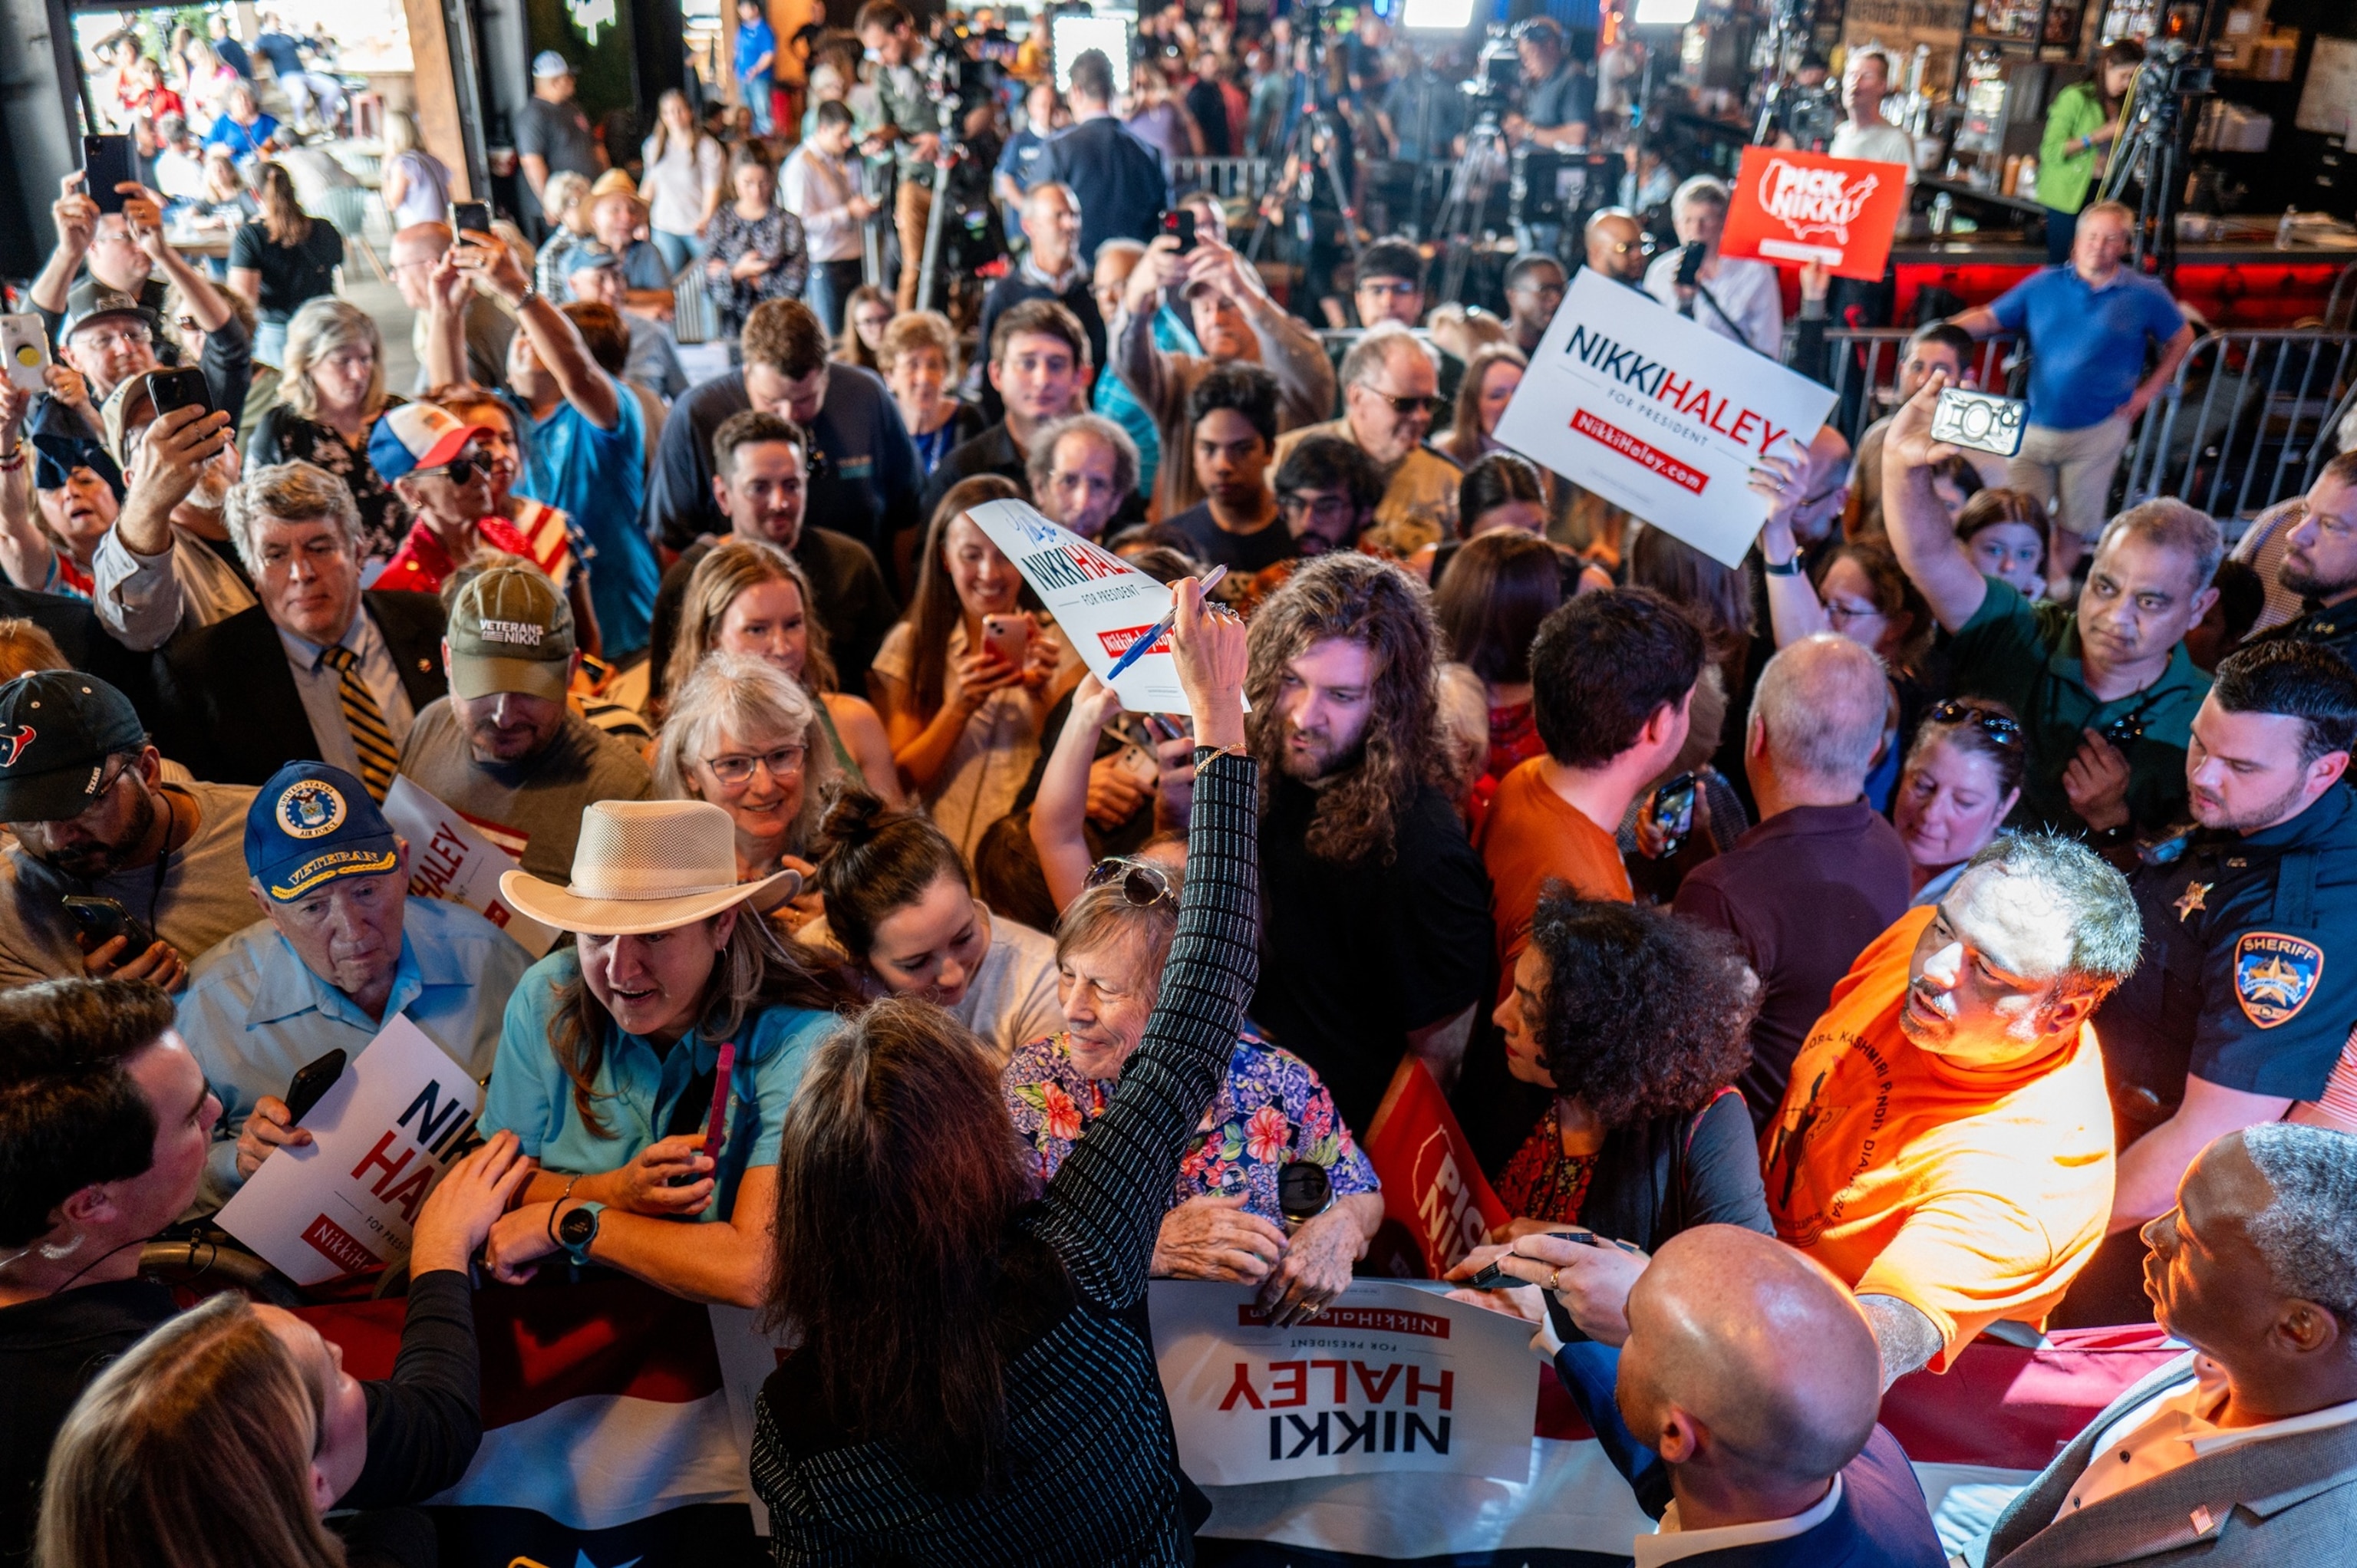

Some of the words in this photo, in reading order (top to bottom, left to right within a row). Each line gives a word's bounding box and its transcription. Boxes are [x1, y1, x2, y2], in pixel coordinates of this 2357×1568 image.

[1777, 166, 1848, 198] PICK
[1769, 191, 1851, 225] NIKKI
[1607, 388, 1633, 409] FOR
[1637, 404, 1709, 447] PRESIDENT
[1577, 414, 1701, 489] NikkiHaley.com
[1081, 593, 1099, 605] FOR
[1096, 584, 1140, 603] PRESIDENT
[479, 618, 543, 635] VETERANS
[504, 631, 540, 646] NIKKI
[84, 766, 101, 794] TEXANS
[279, 784, 302, 808] UNITED
[304, 781, 335, 793] STATES
[315, 822, 338, 835] FORCE
[288, 851, 380, 885] VETERAN
[2243, 937, 2317, 960] SHERIFF
[1839, 1031, 1890, 1078] KASHMIRI
[1870, 1080, 1893, 1132] PNDIT
[1435, 1151, 1492, 1252] PIC
[366, 1216, 384, 1234] FOR
[1291, 1339, 1363, 1349] PRESIDENT
[1370, 1342, 1397, 1352] FOR
[1218, 1360, 1455, 1411] HALEY
[1270, 1410, 1451, 1461] NIKKI
